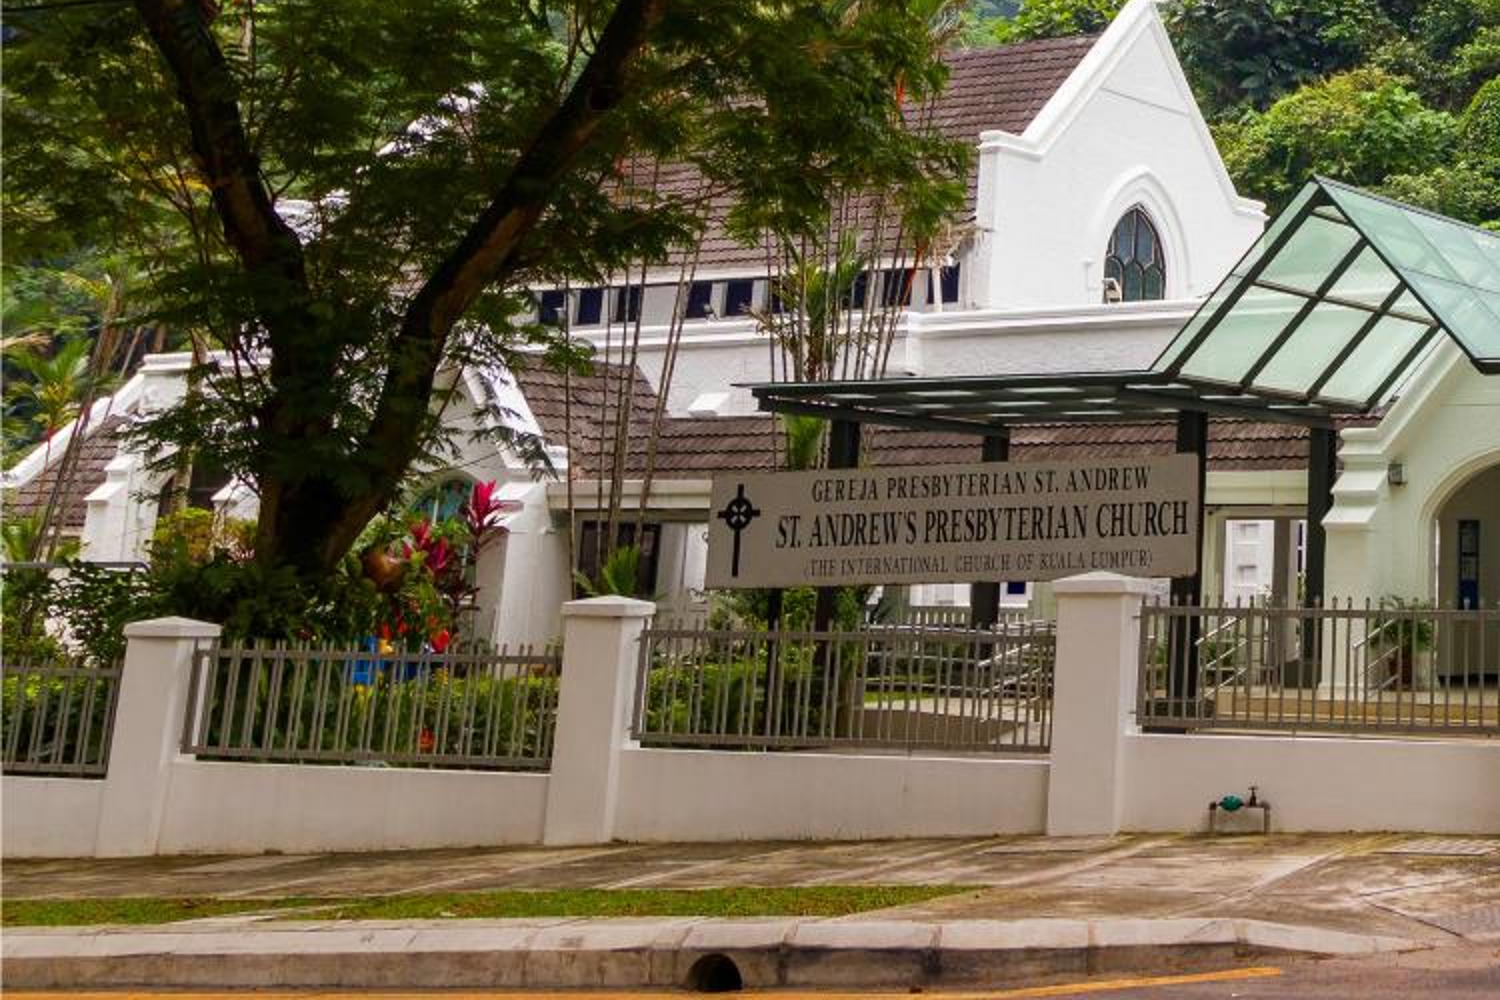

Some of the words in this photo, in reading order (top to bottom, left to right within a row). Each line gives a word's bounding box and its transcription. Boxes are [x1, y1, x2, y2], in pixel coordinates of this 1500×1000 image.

[812, 478, 878, 502] GEREJA
[887, 471, 1027, 499] PRESBYTERIAN
[1034, 470, 1059, 494] ST.
[1066, 466, 1150, 492] ANDREW
[775, 514, 800, 548] ST.
[809, 511, 917, 547] ANDREW'S
[924, 503, 1088, 544] PRESBYTERIAN
[1096, 501, 1188, 538] CHURCH
[804, 558, 835, 579] (THE
[841, 555, 949, 577] INTERNATIONAL
[955, 552, 1010, 573] CHURCH
[1017, 552, 1034, 570] OF
[1040, 551, 1085, 570] KUALA
[1091, 549, 1152, 569] LUMPUR)
